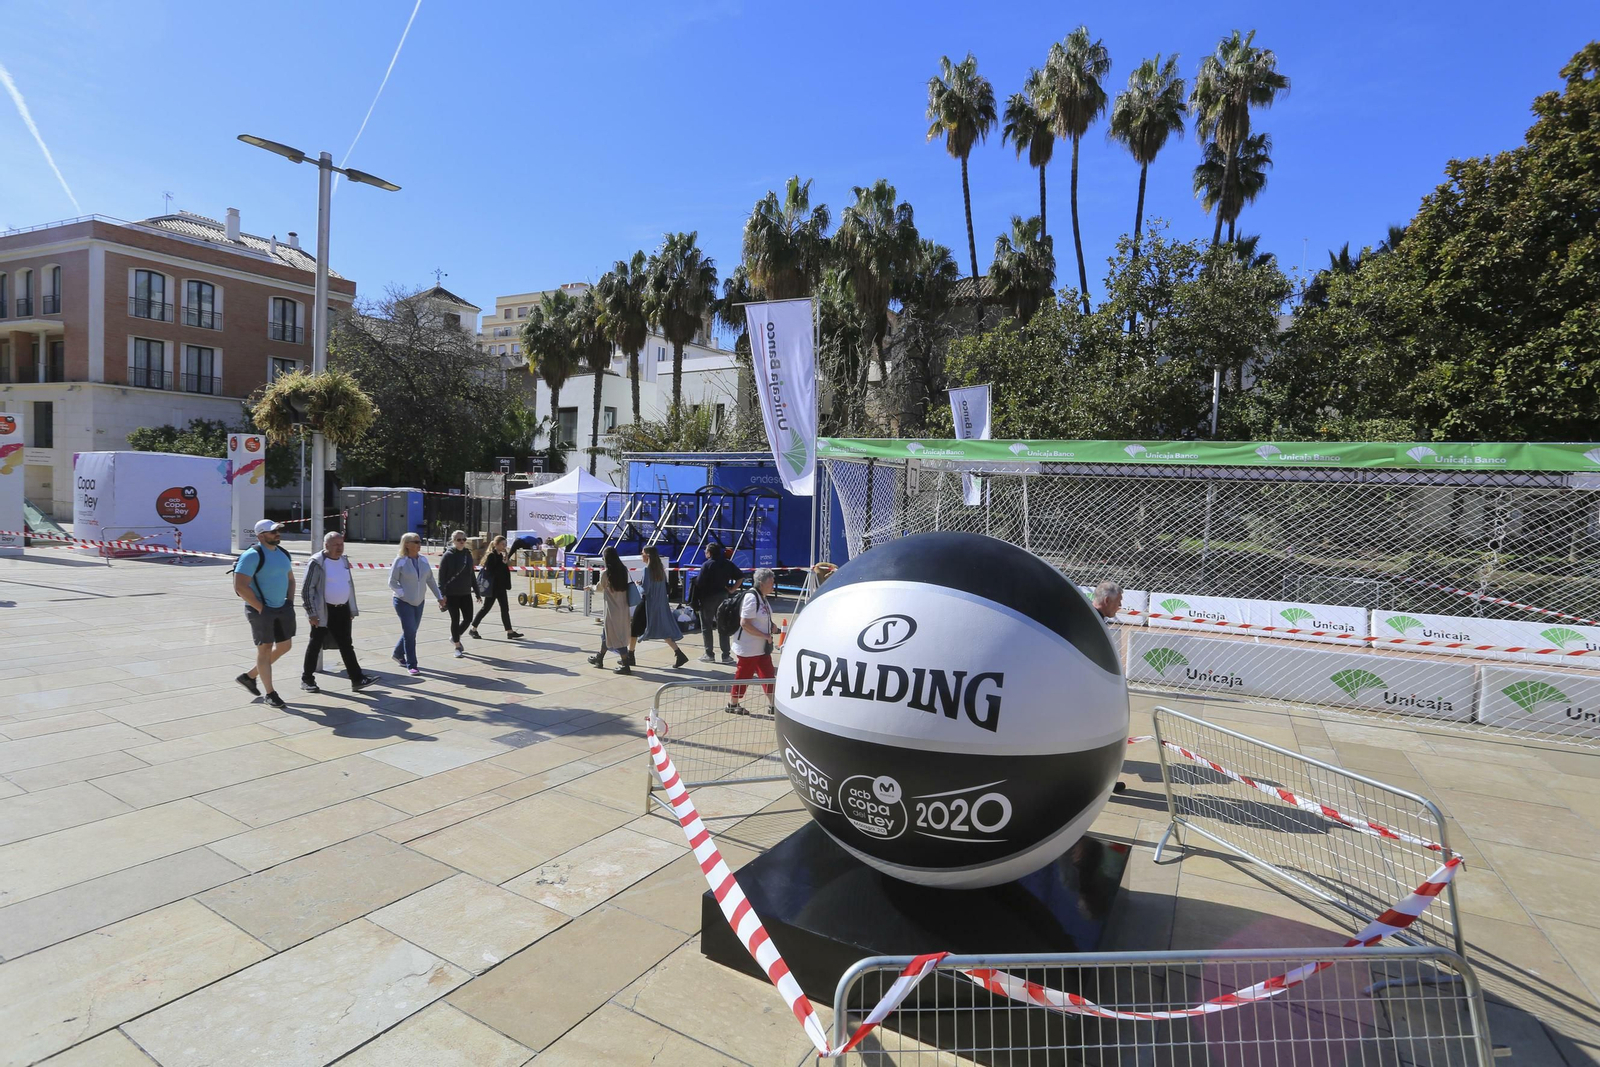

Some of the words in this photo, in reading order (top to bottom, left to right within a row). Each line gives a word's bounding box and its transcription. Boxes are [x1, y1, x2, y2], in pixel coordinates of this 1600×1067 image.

[1026, 450, 1053, 458] Unicaja
[1145, 452, 1174, 460] Unicaja
[1279, 453, 1312, 462] Unicaja
[1434, 455, 1473, 465] Unicaja
[1474, 456, 1507, 464] Banco
[78, 476, 96, 492] Copa
[84, 493, 98, 511] Rey
[529, 511, 567, 521] divinapastora
[1188, 609, 1226, 621] Unicaja
[1312, 620, 1355, 633] Unicaja
[1423, 629, 1471, 642] Unicaja
[1186, 668, 1243, 688] Unicaja
[790, 648, 1004, 733] SPALDING
[1383, 691, 1453, 713] Unicaja
[809, 786, 832, 809] rey
[849, 788, 871, 800] acb
[916, 792, 1013, 833] 2020
[867, 814, 894, 830] rey
